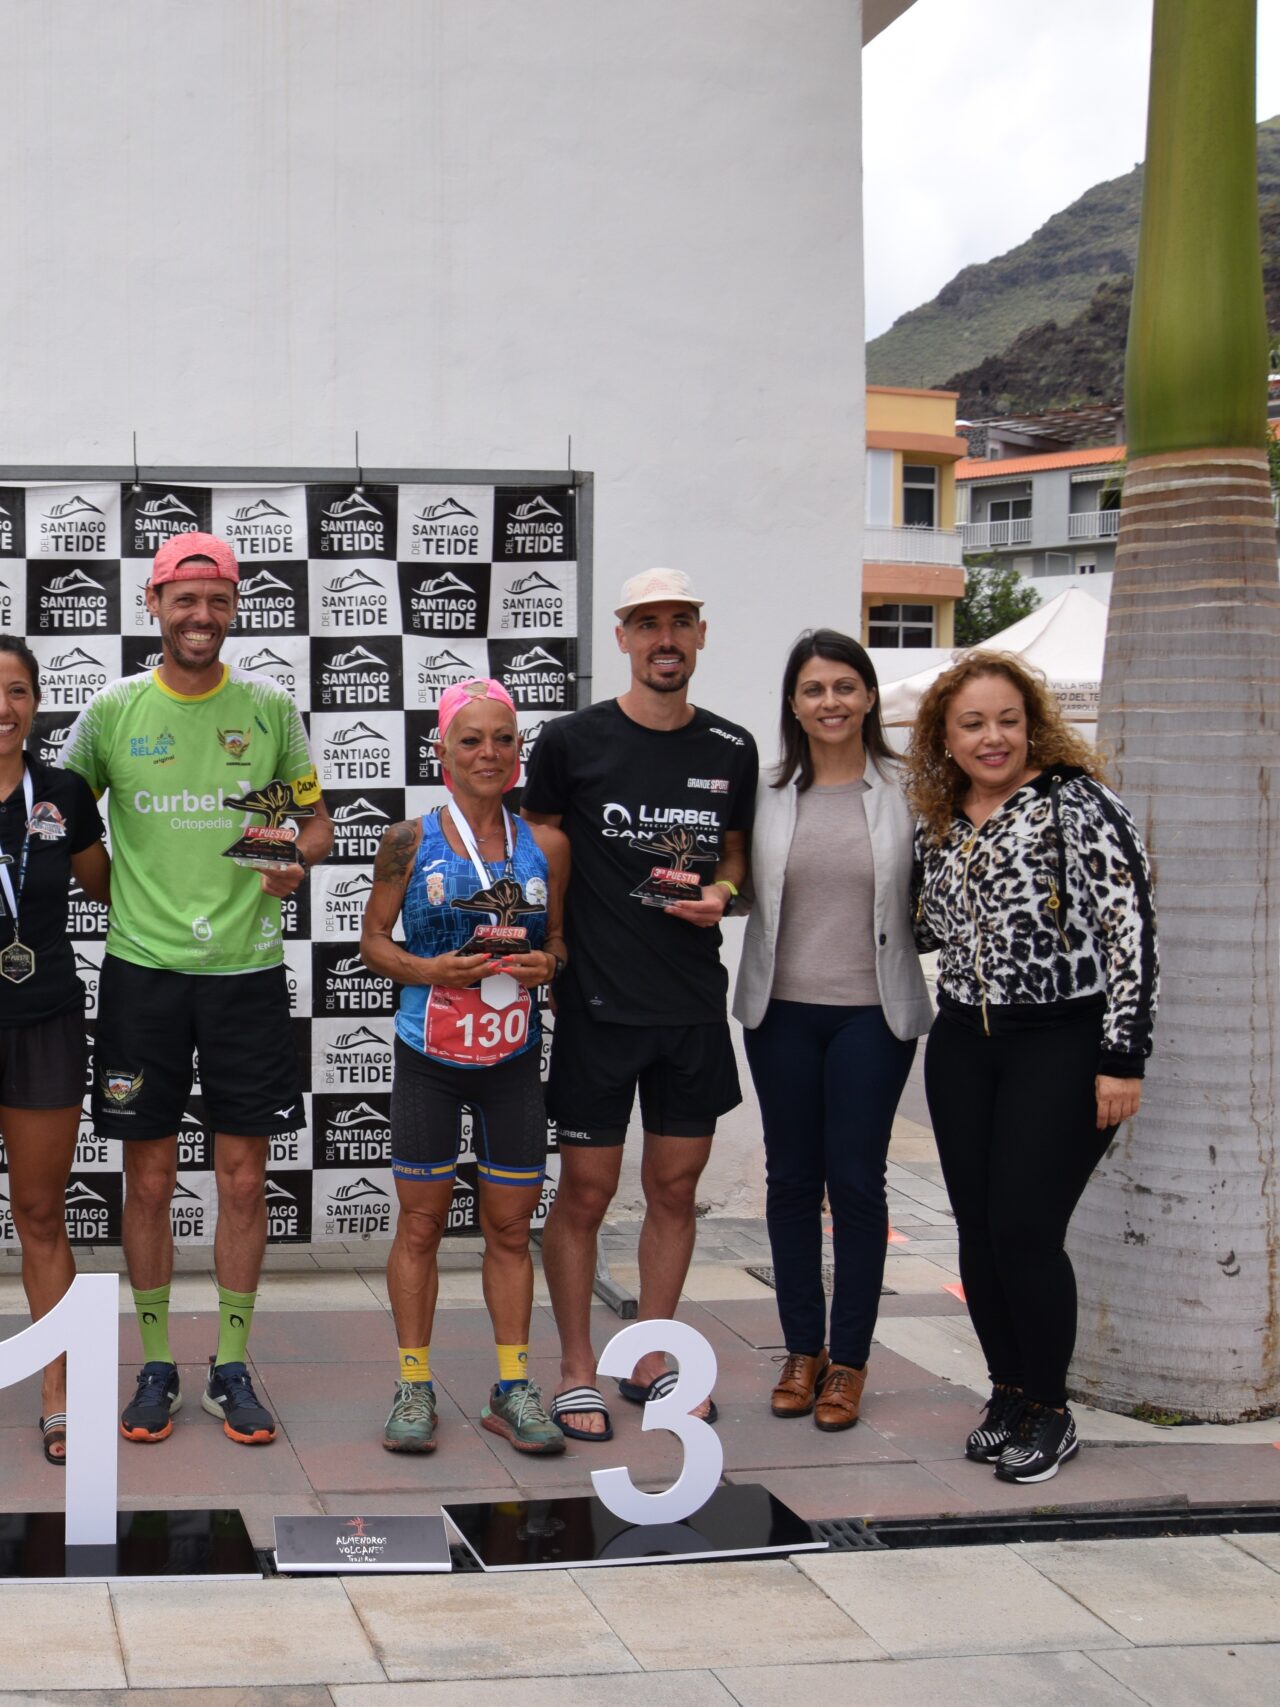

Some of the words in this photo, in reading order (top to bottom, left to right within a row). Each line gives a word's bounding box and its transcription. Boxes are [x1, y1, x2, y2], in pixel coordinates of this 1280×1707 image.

[42, 522, 106, 533] SANTIAGO
[135, 518, 199, 532] SANTIAGO
[226, 525, 292, 536] SANTIAGO
[321, 520, 383, 532] SANTIAGO
[413, 525, 478, 536] SANTIAGO
[507, 523, 563, 534] SANTIAGO
[52, 535, 105, 552] TEIDE
[237, 537, 292, 554] TEIDE
[330, 533, 384, 551] TEIDE
[423, 538, 478, 555] TEIDE
[515, 536, 563, 553] TEIDE
[41, 596, 107, 608] SANTIAGO
[237, 596, 295, 609] ANTIAGO
[322, 595, 386, 607] SANTIAGO
[411, 598, 476, 610] SANTIAGO
[503, 598, 562, 609] SANTIAGO
[51, 609, 107, 627] TEIDE
[236, 611, 295, 628] TEIDE
[331, 608, 387, 626] TEIDE
[420, 612, 475, 629] TEIDE
[511, 611, 562, 628] TEIDE
[40, 674, 106, 685] SANTIAGO
[323, 672, 389, 684] SANTIAGO
[504, 673, 564, 685] SANTIAGO
[332, 685, 389, 703] TEIDE
[514, 686, 564, 703] TEIDE
[131, 747, 168, 757] RELAX
[324, 748, 389, 760] SANTIAGO
[334, 762, 390, 779] TEIDE
[639, 805, 720, 827] LURBEL
[170, 817, 233, 831] Ortopedia
[259, 828, 293, 839] PUESTO
[666, 870, 698, 884] PUESTO
[66, 915, 108, 932] EIDE
[491, 928, 524, 938] PUESTO
[327, 978, 392, 989] SANTIAGO
[336, 992, 392, 1008] TEIDE
[456, 1009, 525, 1048] 130
[326, 1053, 391, 1064] SANTIAGO
[337, 1066, 391, 1083] TEIDE
[326, 1129, 391, 1141] SANTIAGO
[336, 1142, 392, 1160] TEIDE
[327, 1203, 390, 1216] SANTIAGO
[67, 1222, 109, 1238] EIDE
[337, 1216, 389, 1233] TEIDE
[591, 1319, 723, 1524] 3
[336, 1536, 387, 1545] ALMENDROS
[339, 1546, 384, 1555] VOLCANES
